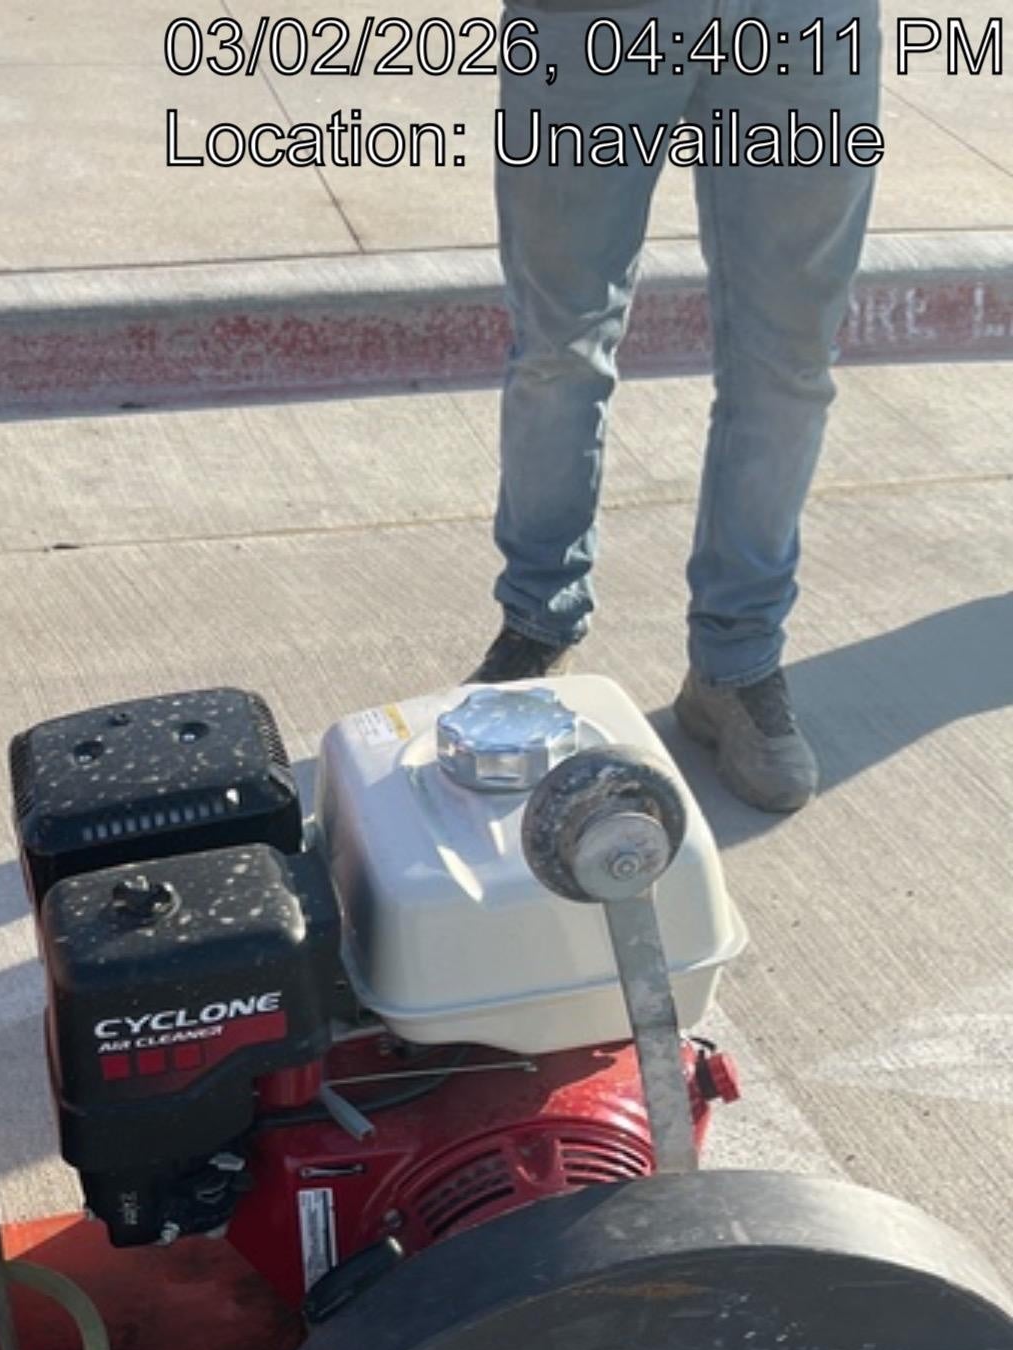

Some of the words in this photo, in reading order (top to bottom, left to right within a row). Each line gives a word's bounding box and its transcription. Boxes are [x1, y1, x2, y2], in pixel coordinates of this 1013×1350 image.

[94, 990, 283, 1038] CYCLONE
[98, 1038, 131, 1054] AIR
[135, 1025, 223, 1048] CLEANER
